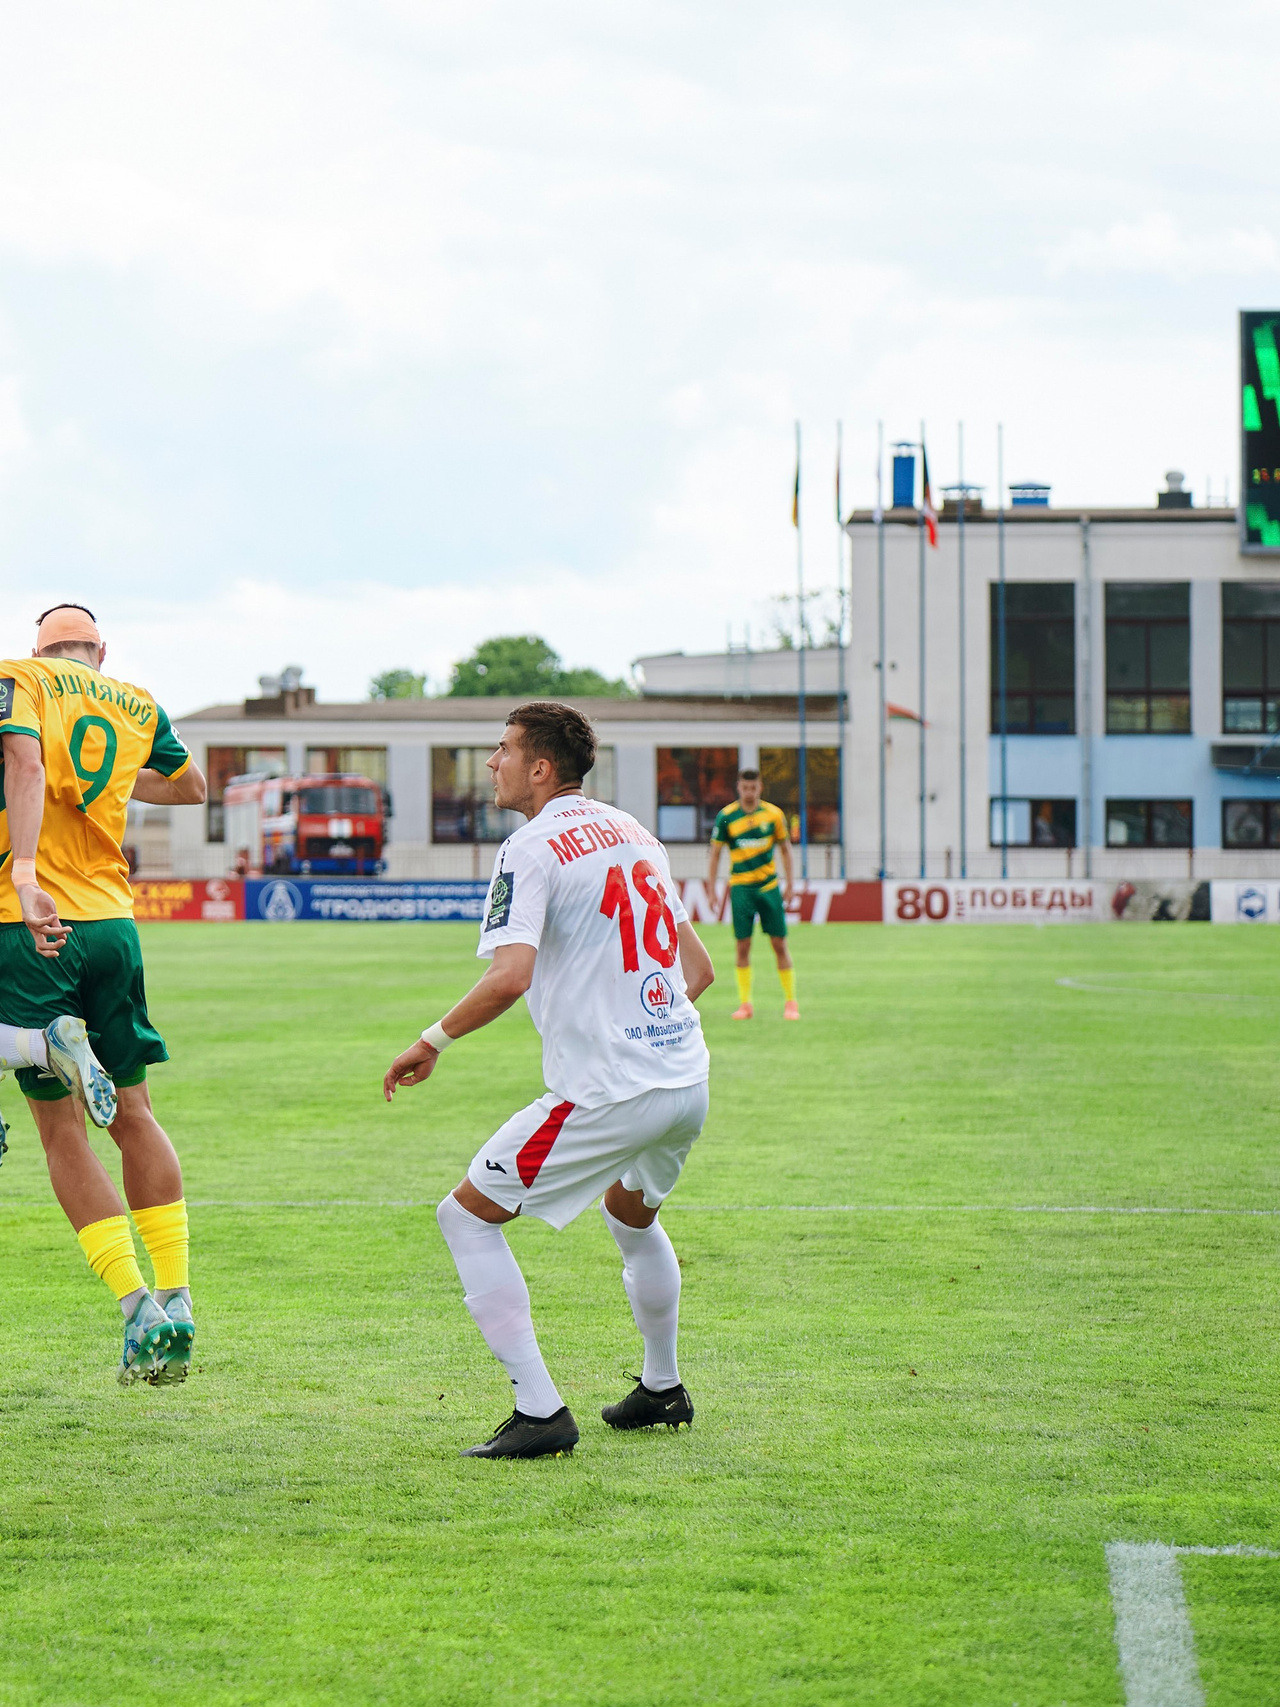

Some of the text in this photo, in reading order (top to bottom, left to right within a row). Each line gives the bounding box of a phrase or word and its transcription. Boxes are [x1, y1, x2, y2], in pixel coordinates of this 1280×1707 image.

[69, 714, 118, 814] 9
[599, 859, 679, 974] 18
[896, 888, 950, 921] 80
[971, 888, 1093, 911] ПОБЕДЫ
[656, 1007, 671, 1019] ОА
[624, 1026, 643, 1040] ОАО
